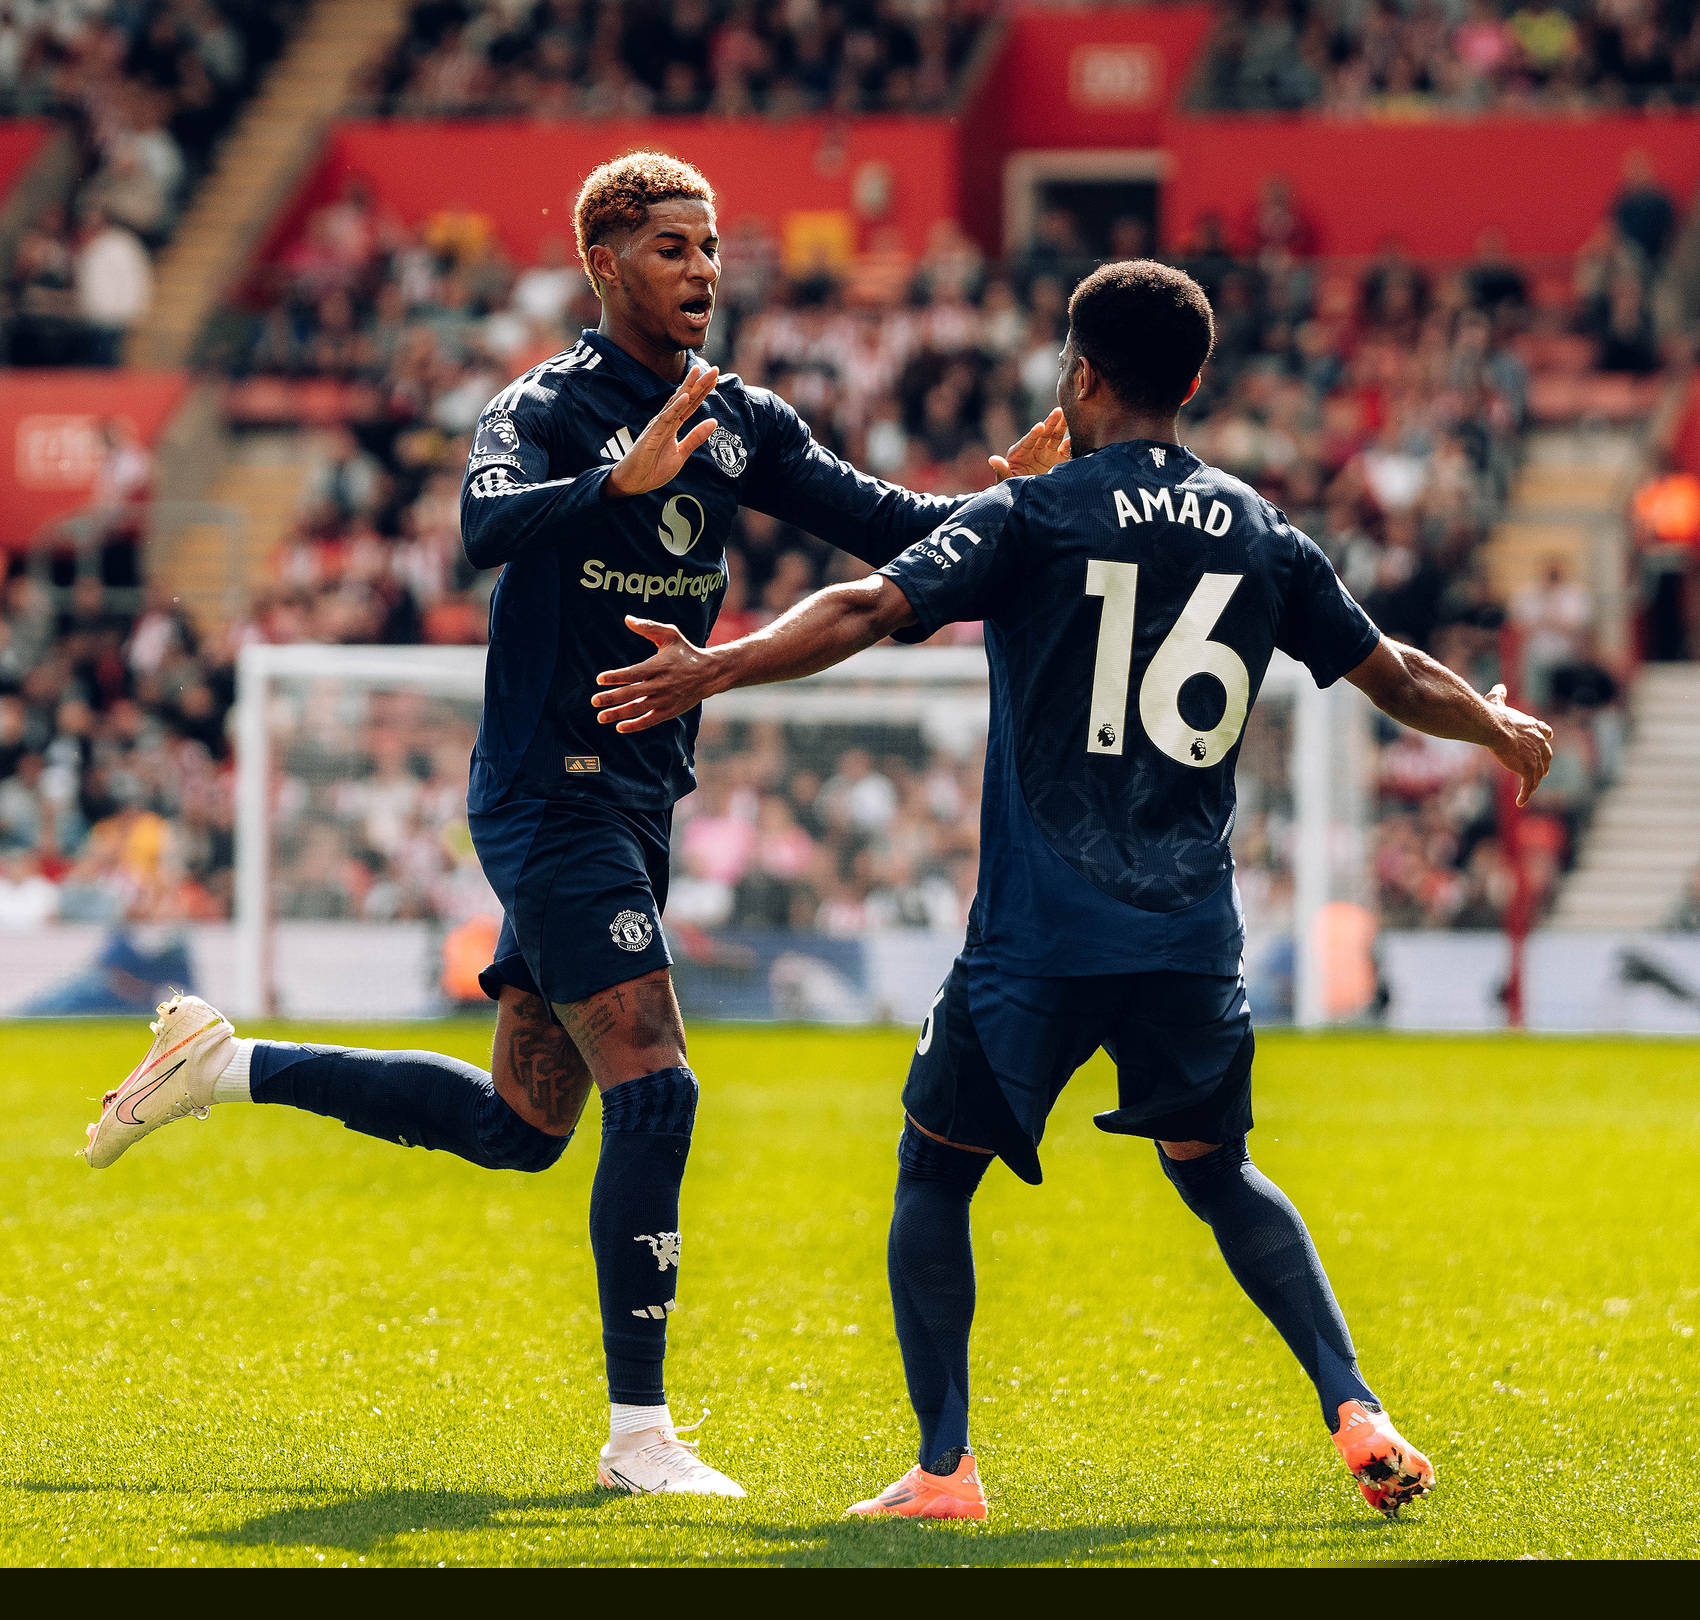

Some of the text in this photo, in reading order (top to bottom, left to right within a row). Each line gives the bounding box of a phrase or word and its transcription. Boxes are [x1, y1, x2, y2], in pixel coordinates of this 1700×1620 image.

[1113, 487, 1233, 538] AMAD
[580, 559, 725, 603] Snapdragon
[1085, 559, 1250, 769] 16
[613, 912, 646, 932] MANCHESTER
[626, 938, 649, 950] UNITED
